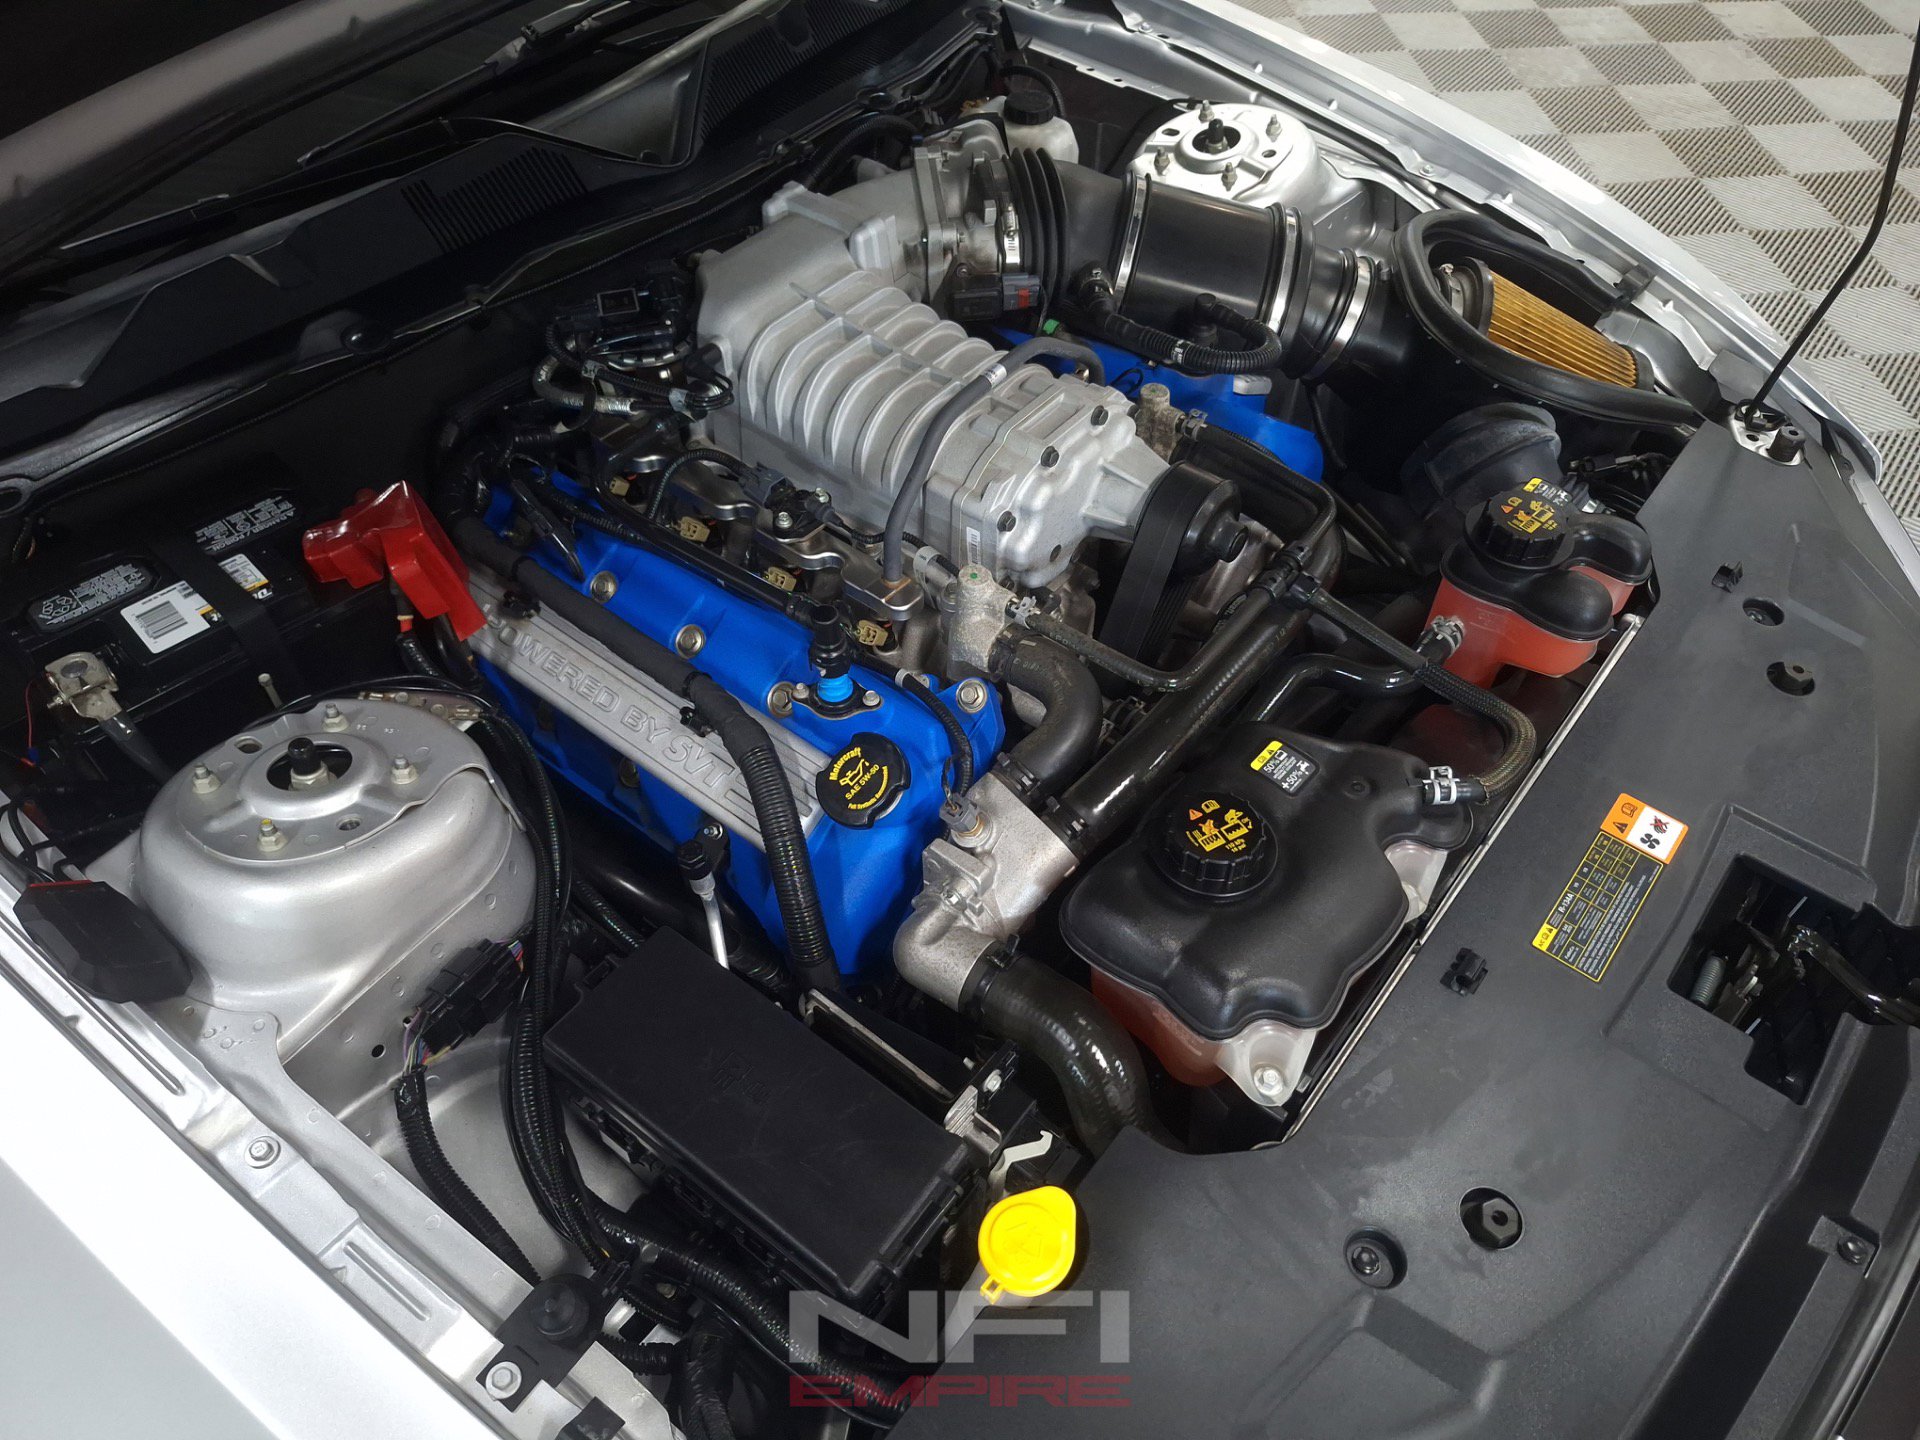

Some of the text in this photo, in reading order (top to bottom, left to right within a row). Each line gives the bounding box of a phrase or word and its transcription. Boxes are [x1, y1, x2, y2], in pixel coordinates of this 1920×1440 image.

[620, 704, 671, 743] BY
[663, 735, 735, 787] SVT
[829, 747, 861, 780] Motorcraft
[1263, 759, 1280, 773] 50%
[845, 783, 862, 800] SAE
